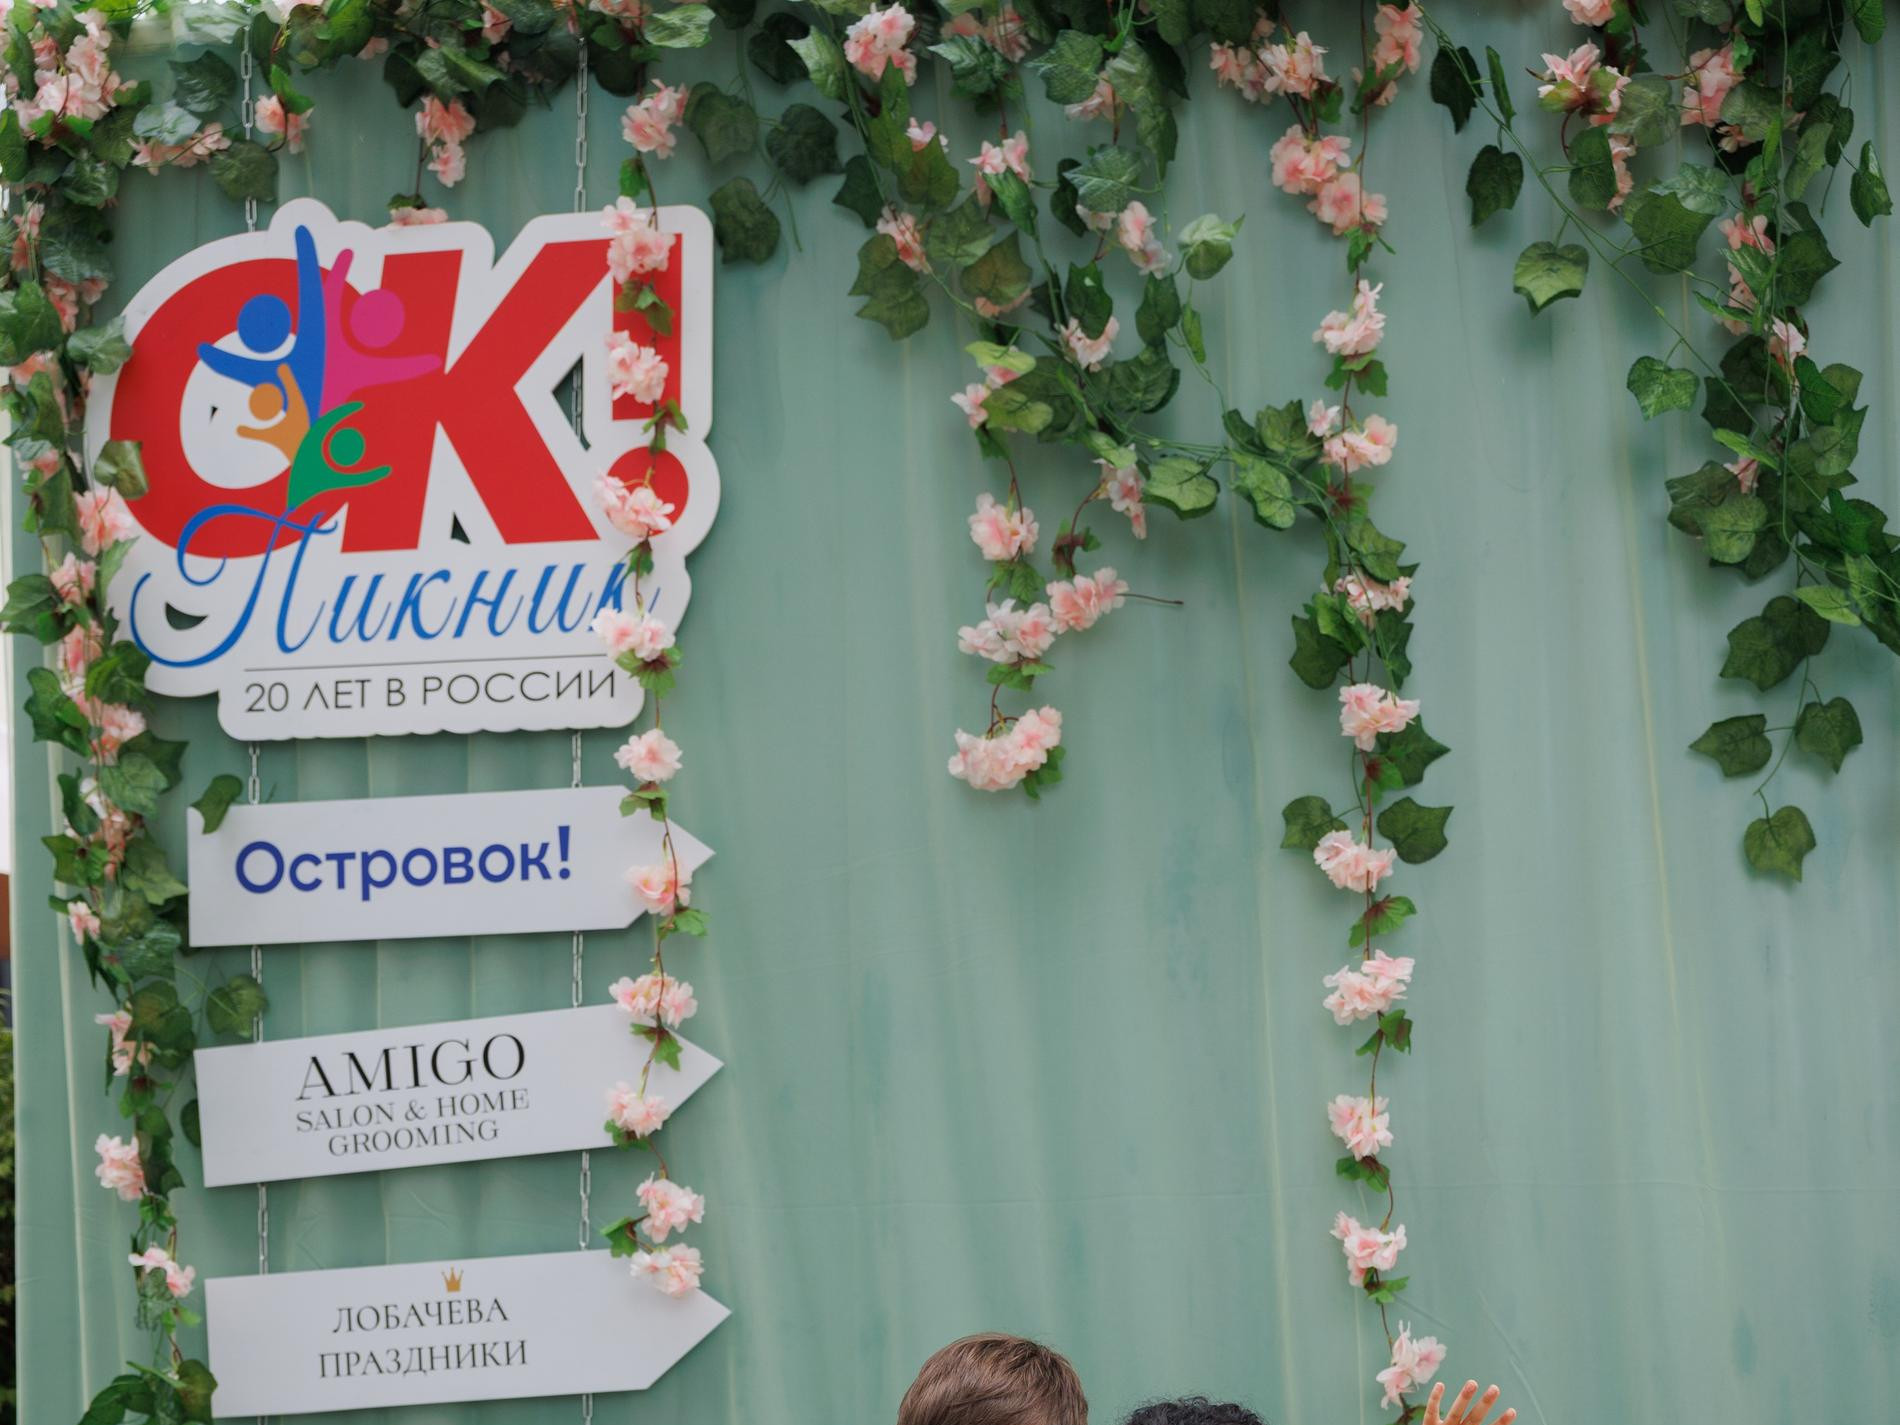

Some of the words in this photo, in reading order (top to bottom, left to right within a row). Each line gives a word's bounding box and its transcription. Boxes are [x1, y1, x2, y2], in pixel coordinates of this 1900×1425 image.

[245, 681, 290, 713] 20
[302, 678, 373, 711] ЛЕТ
[386, 677, 406, 708] В
[423, 669, 617, 706] РОССИИ
[234, 825, 573, 902] Островок!
[296, 1033, 526, 1101] AMIGO
[296, 1102, 396, 1133] SALON
[404, 1099, 428, 1122] &
[437, 1088, 530, 1119] HOME
[328, 1118, 500, 1157] GROOMING
[332, 1297, 510, 1334] ЛОБАЧЕВА
[318, 1339, 529, 1379] ПРАЗДНИКИ
